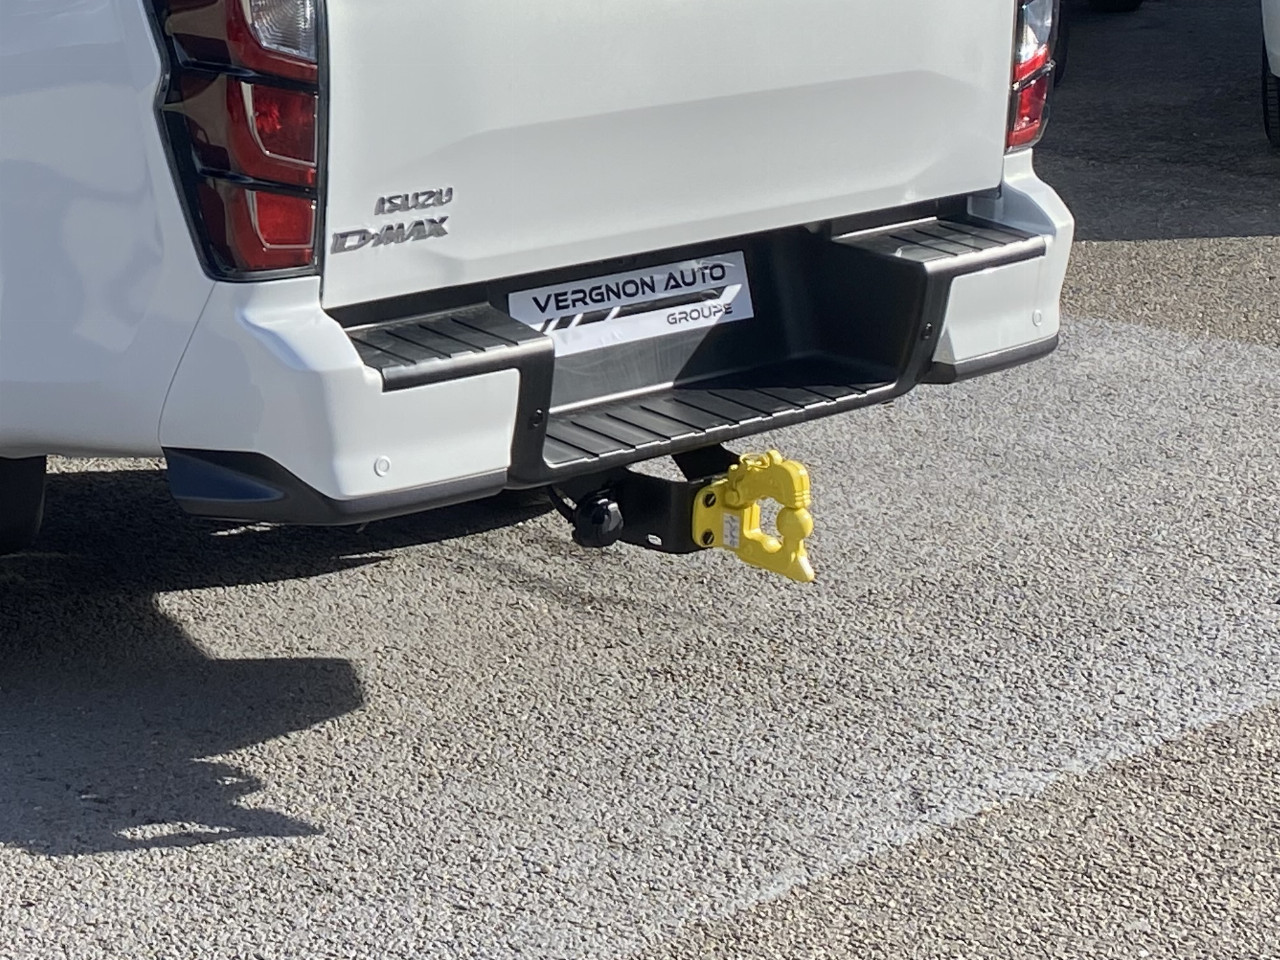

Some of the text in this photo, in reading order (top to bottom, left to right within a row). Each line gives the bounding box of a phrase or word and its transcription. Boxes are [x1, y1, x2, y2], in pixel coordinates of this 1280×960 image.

[374, 187, 453, 216] ISUZU
[531, 263, 727, 314] VERGNON AUTO
[666, 302, 734, 326] GROUPE
